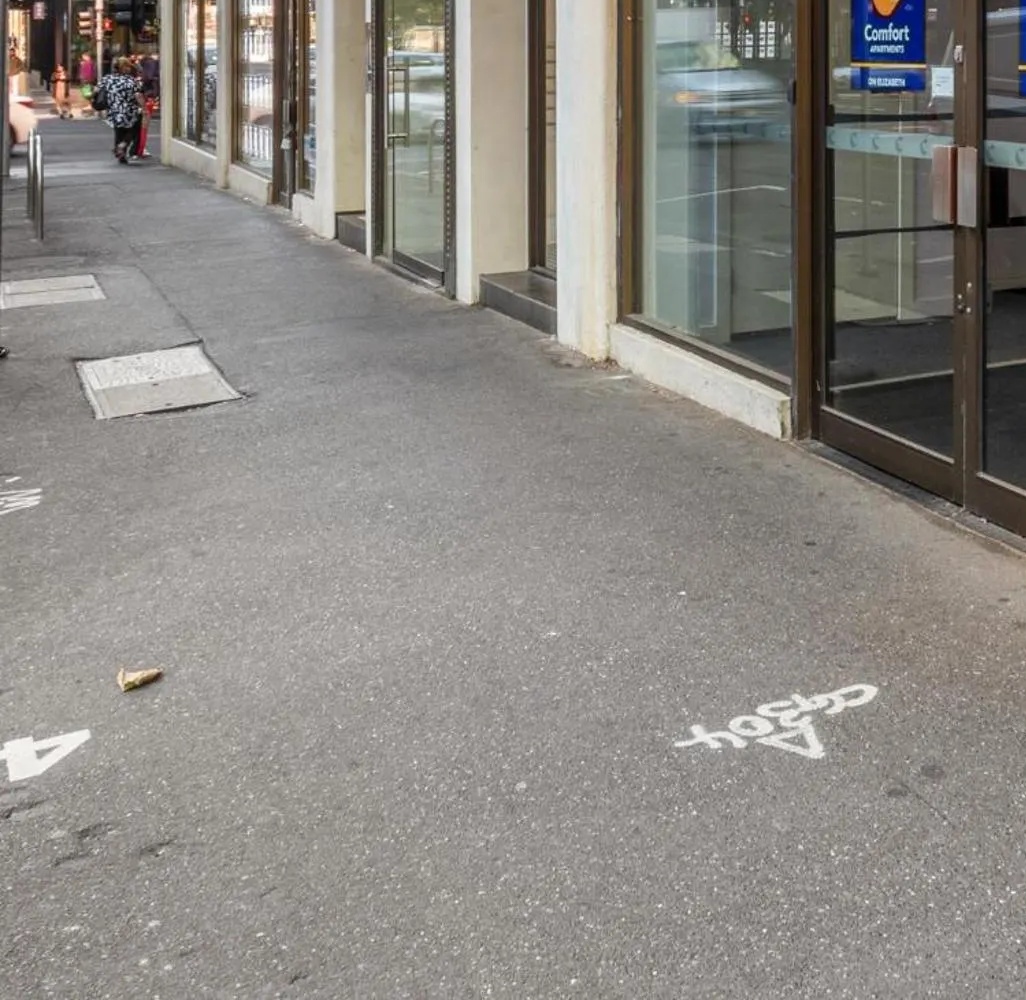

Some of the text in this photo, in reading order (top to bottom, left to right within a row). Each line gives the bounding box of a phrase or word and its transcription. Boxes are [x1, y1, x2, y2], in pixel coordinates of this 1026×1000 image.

[864, 22, 910, 41] Comfort
[870, 44, 905, 53] APARTMENTS
[868, 77, 906, 87] ON ELIZABETH
